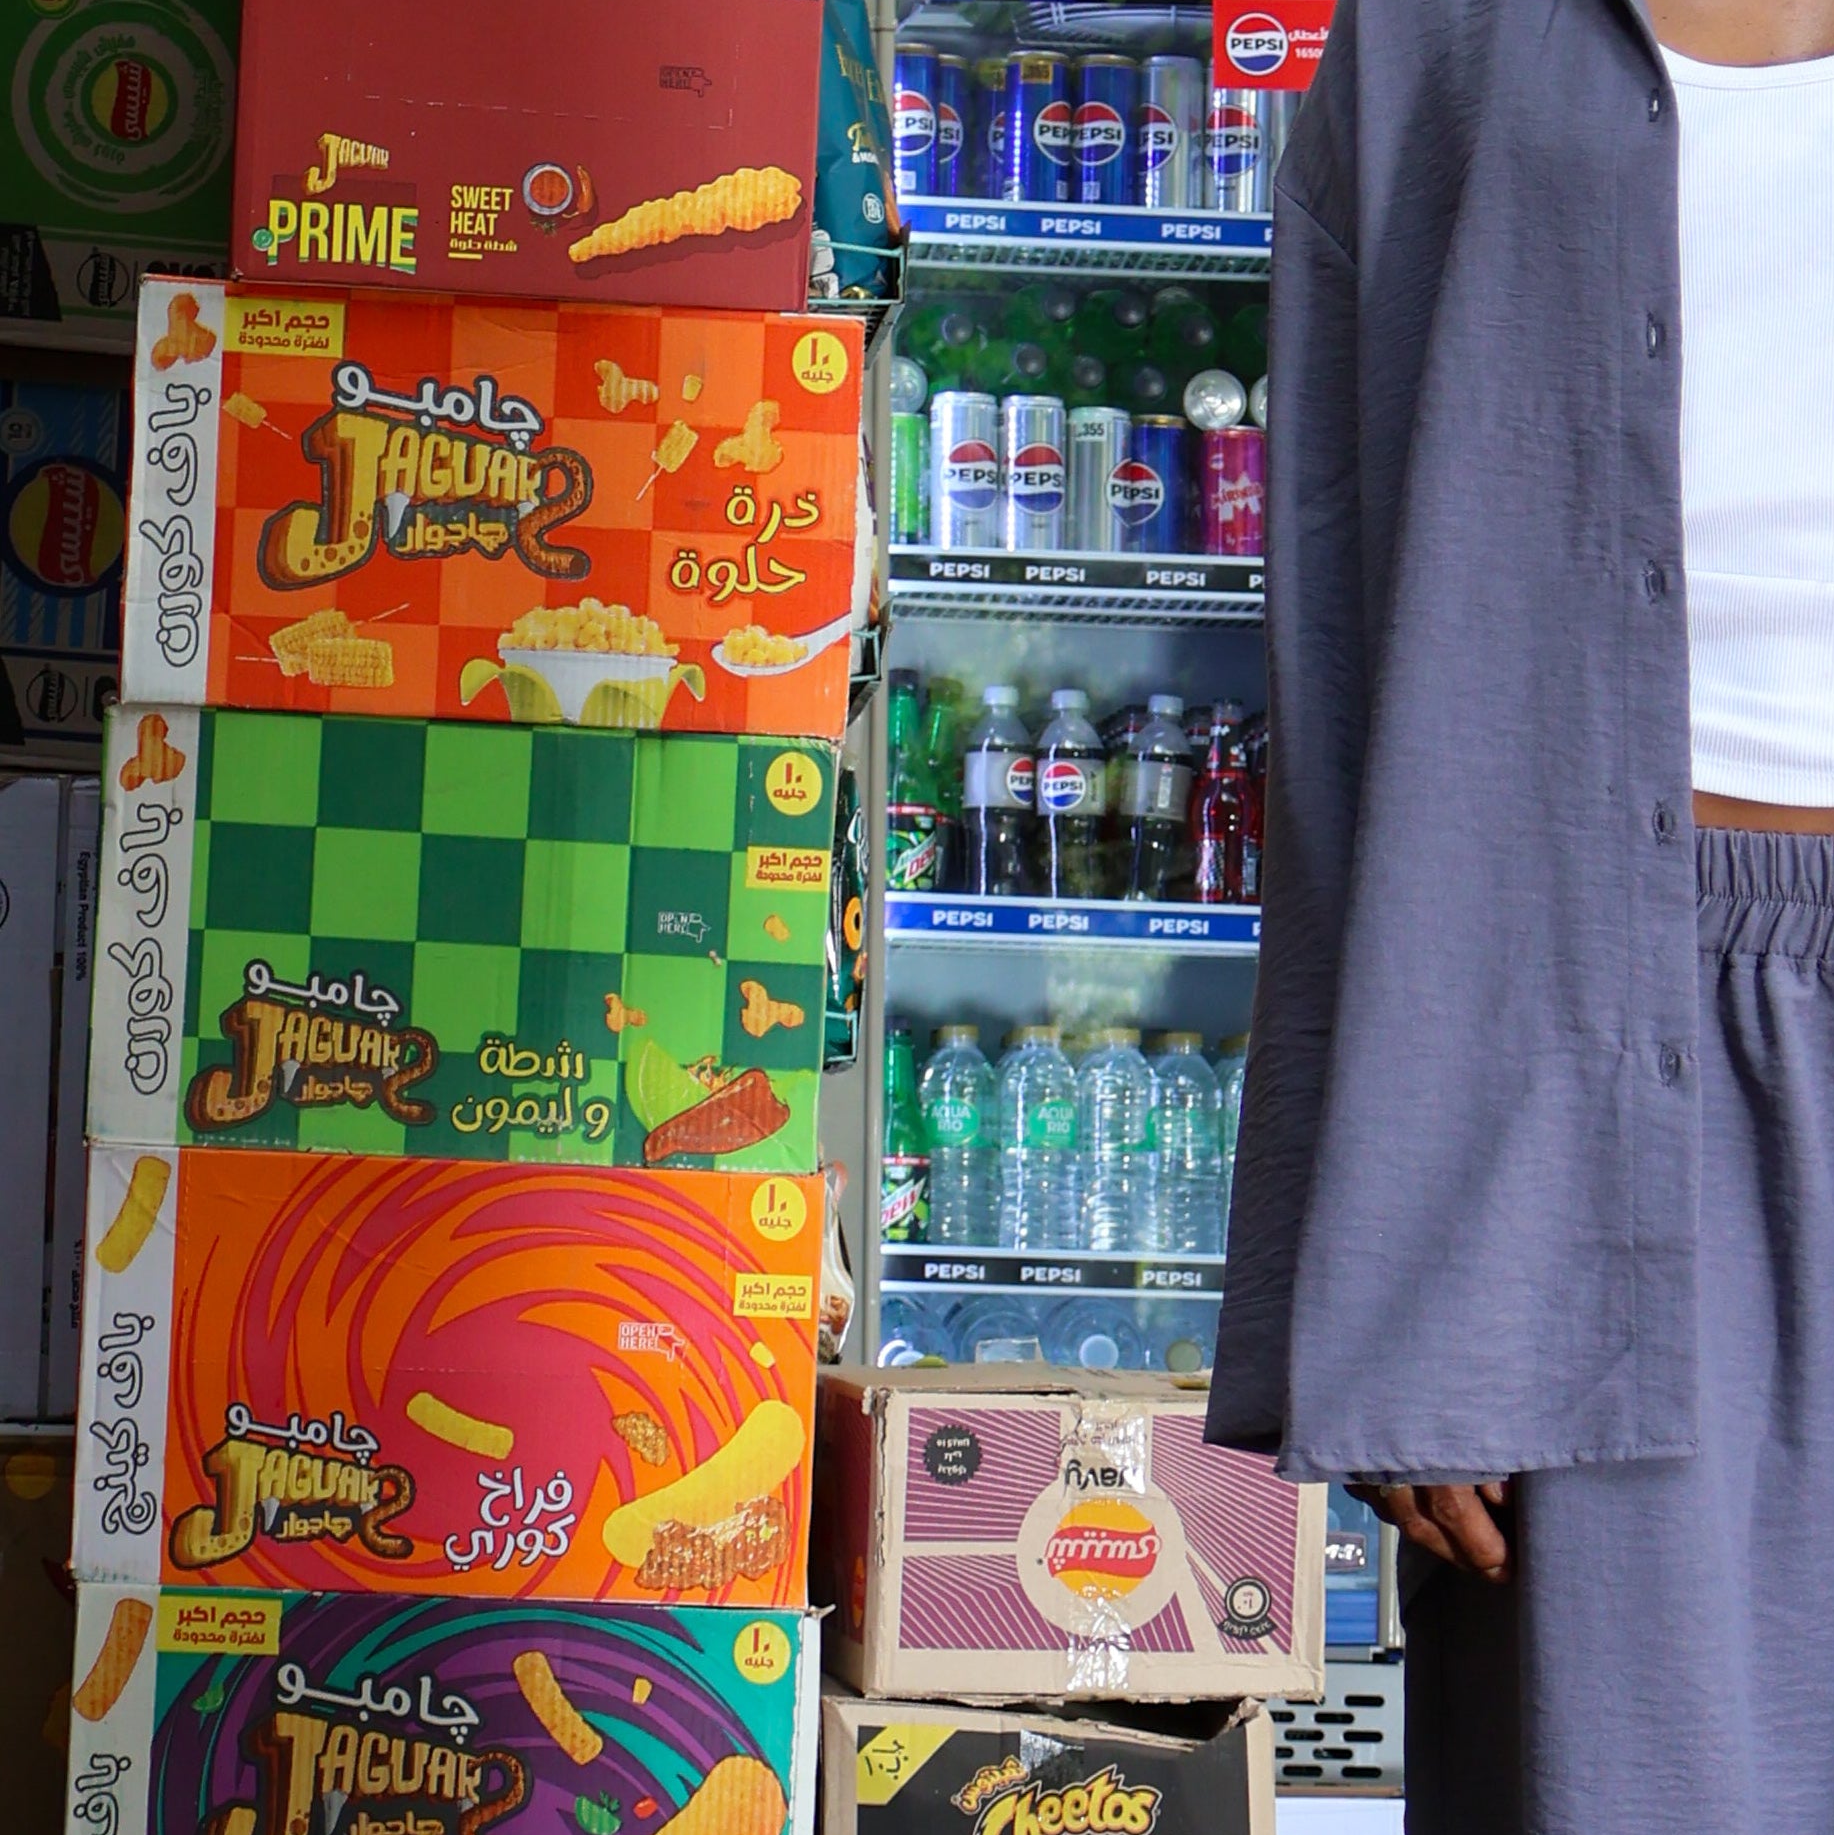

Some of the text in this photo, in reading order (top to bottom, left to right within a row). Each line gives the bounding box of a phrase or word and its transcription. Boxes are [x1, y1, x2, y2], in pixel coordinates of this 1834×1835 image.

[1230, 36, 1285, 53] PEPSI
[303, 134, 391, 197] JAGUAR
[450, 185, 514, 211] SWEET
[267, 198, 419, 275] PRIME
[450, 212, 495, 237] HEAT
[945, 213, 1222, 241] PEPSI PEPSI
[282, 310, 330, 331] حجم
[238, 332, 330, 352] لفترة محدودة
[799, 367, 836, 385] جنيه
[259, 409, 592, 590] JAGUAR
[1110, 484, 1161, 502] PEPSI
[724, 485, 821, 546] ذرة
[669, 544, 808, 605] حلوة
[930, 562, 1206, 588] PEPSI PEPSI
[1042, 779, 1084, 793] PEPSI
[75, 903, 89, 948] Product
[932, 910, 1209, 935] PEPSI PEPSI
[185, 1000, 441, 1130] JAGUAR
[479, 1039, 585, 1082] شطة
[451, 1088, 573, 1135] ليمون
[931, 1105, 972, 1120] AQUA
[938, 1119, 964, 1132] RIO
[925, 1263, 1203, 1288] PEPSI PEPSI
[170, 1440, 415, 1570] JAGUAR
[477, 1469, 574, 1526] فراخ
